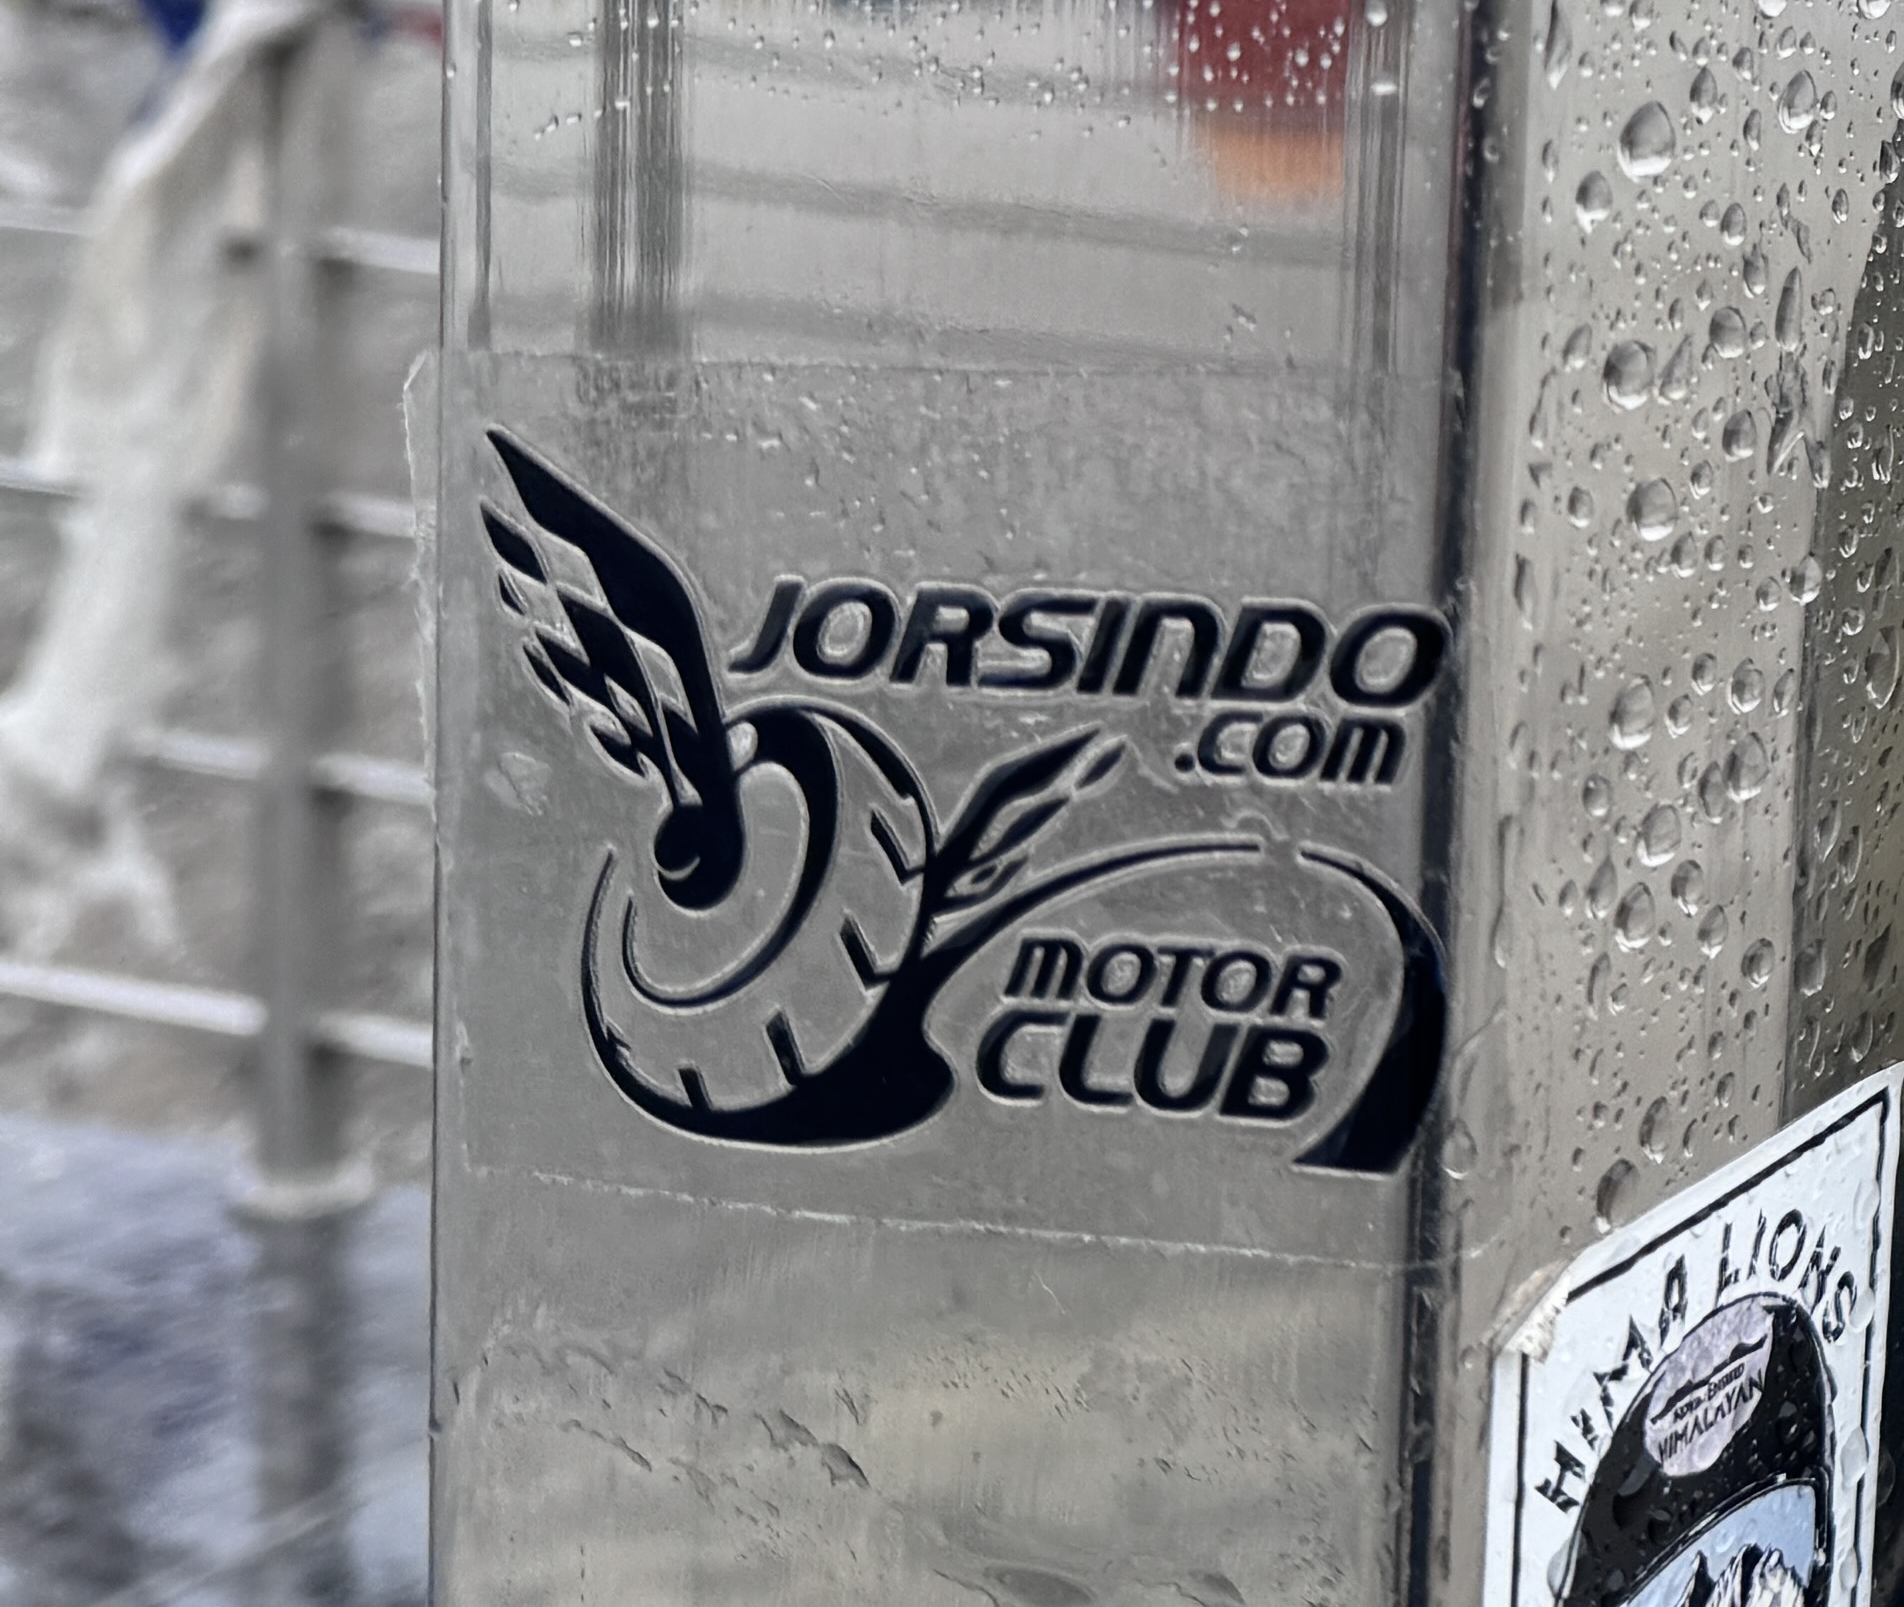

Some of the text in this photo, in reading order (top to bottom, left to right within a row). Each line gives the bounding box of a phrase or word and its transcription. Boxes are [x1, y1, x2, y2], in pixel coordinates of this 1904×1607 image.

[728, 578, 1450, 708] JORSINDO
[1004, 936, 1341, 1021] MOTOR
[976, 1009, 1331, 1123] CLUB
[1715, 1207, 1858, 1345] LIONS
[1658, 1367, 1765, 1464] HIMALAYAN
